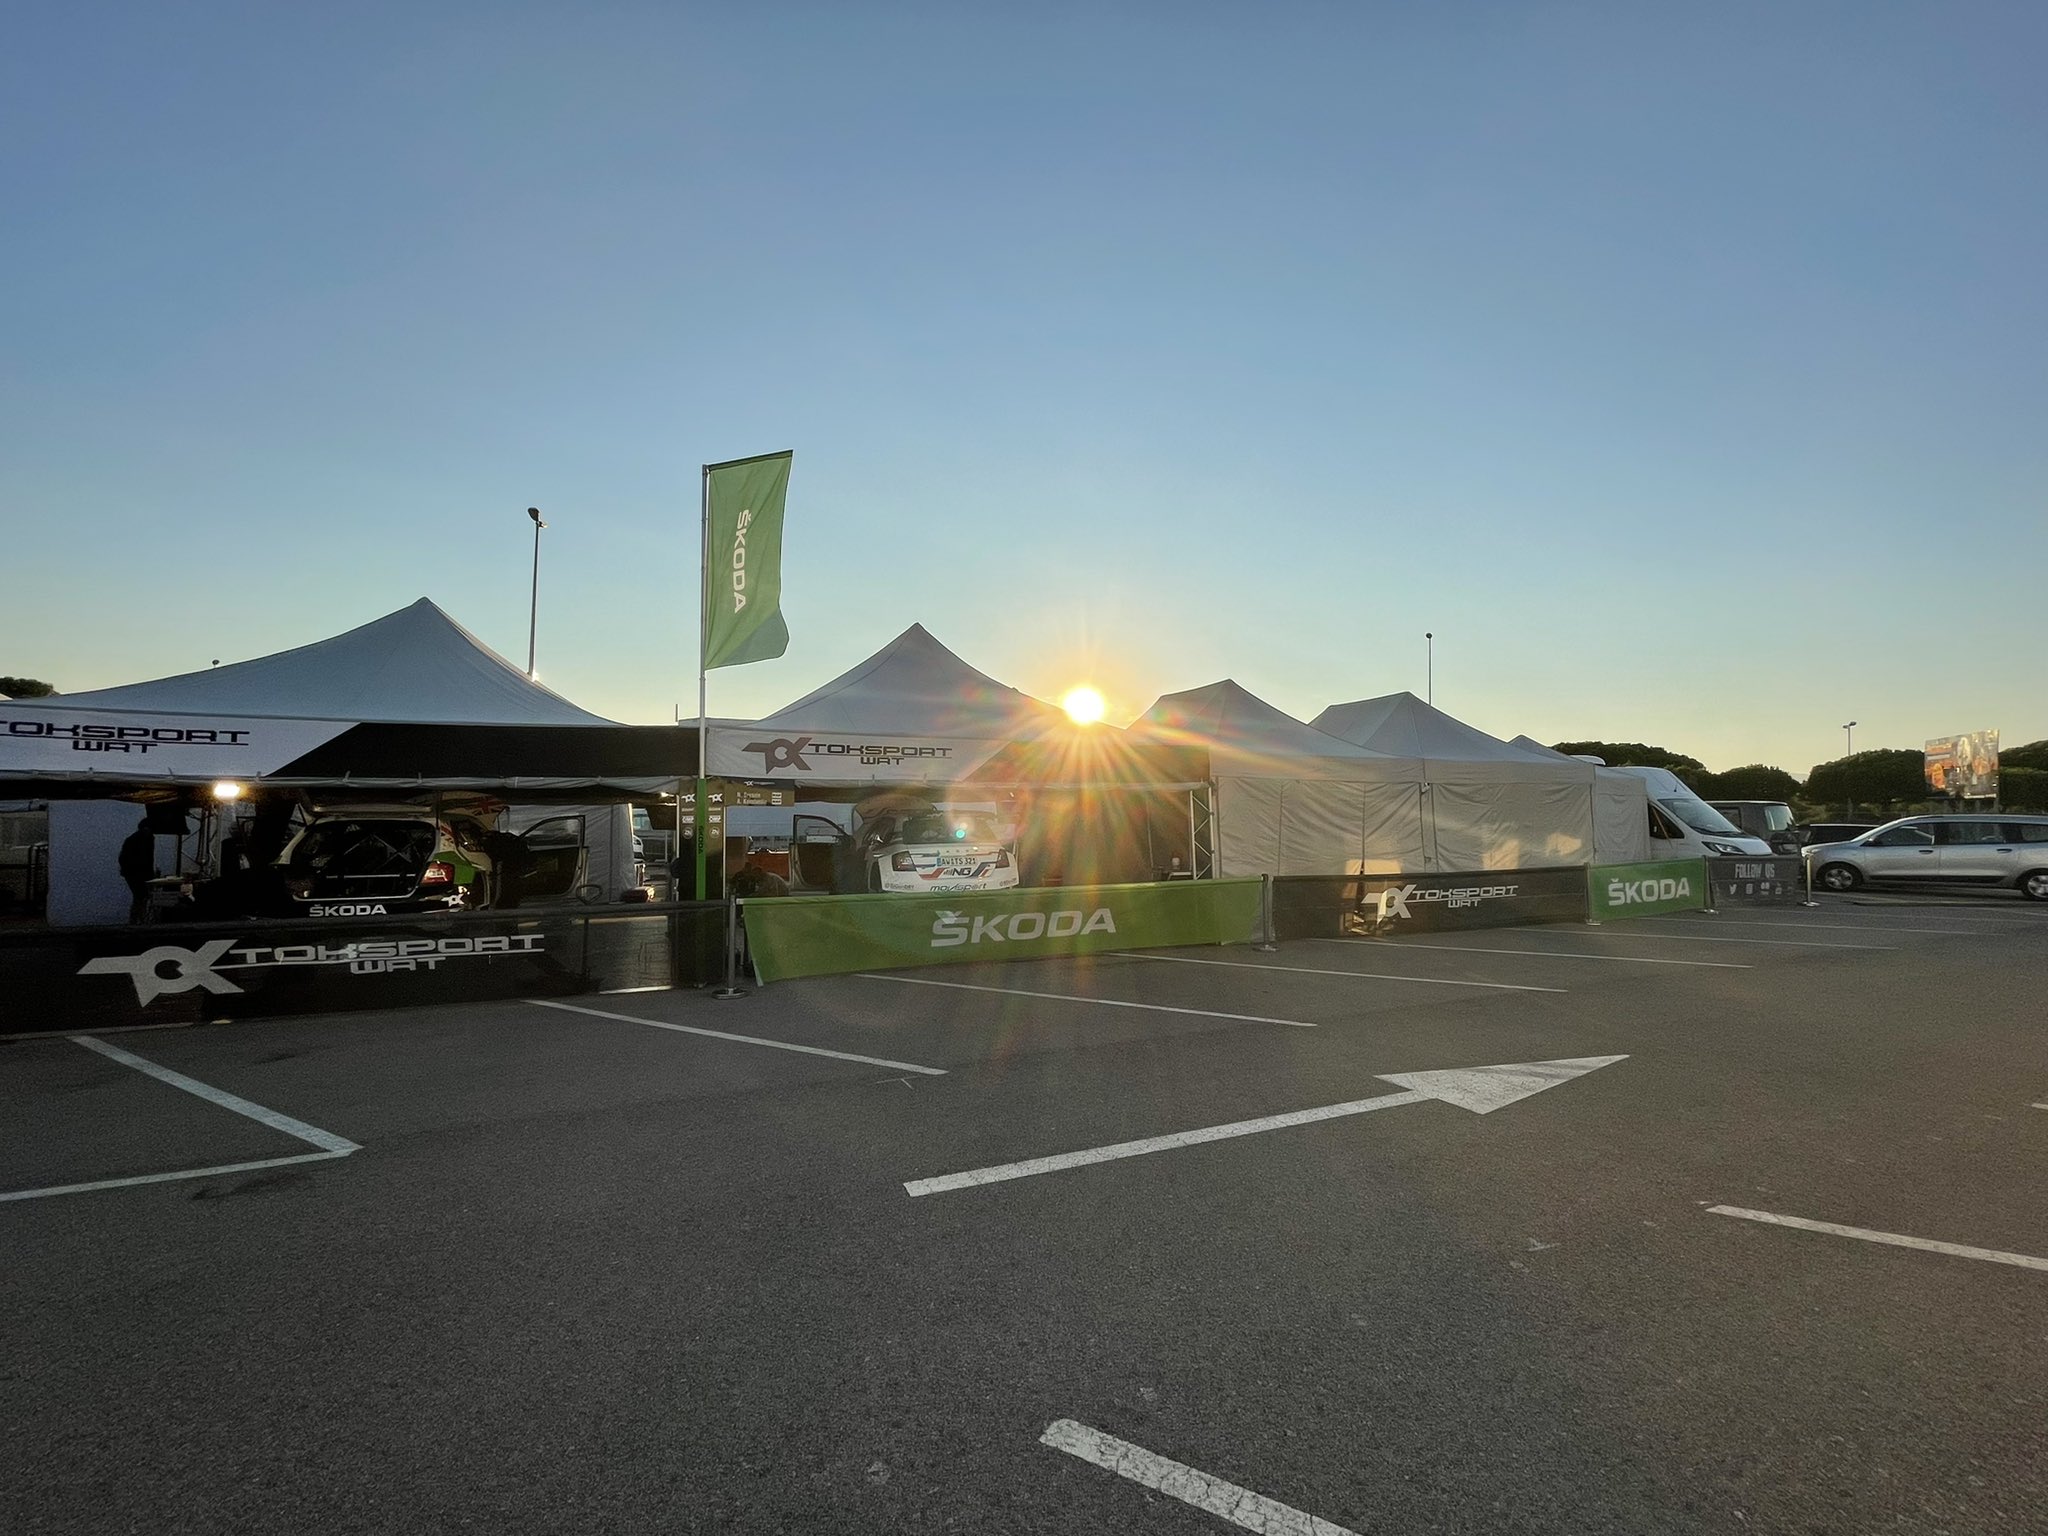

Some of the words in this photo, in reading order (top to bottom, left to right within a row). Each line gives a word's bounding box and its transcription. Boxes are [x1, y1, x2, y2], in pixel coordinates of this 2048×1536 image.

[733, 509, 752, 614] ŠKODA
[0, 720, 250, 743] OKSPORT
[72, 740, 158, 753] WRT
[808, 743, 952, 757] TOKSPORT
[860, 757, 904, 765] WRT
[1734, 864, 1762, 878] FOLLOW
[1765, 864, 1775, 878] US
[1411, 885, 1519, 900] TOKSPORT
[1608, 877, 1690, 906] ŠKODA
[309, 904, 387, 918] ŠKODA
[1448, 899, 1481, 908] WRT
[931, 908, 1117, 947] ŠKODA
[229, 934, 545, 964] TOKSPORT
[350, 957, 447, 974] WRT
